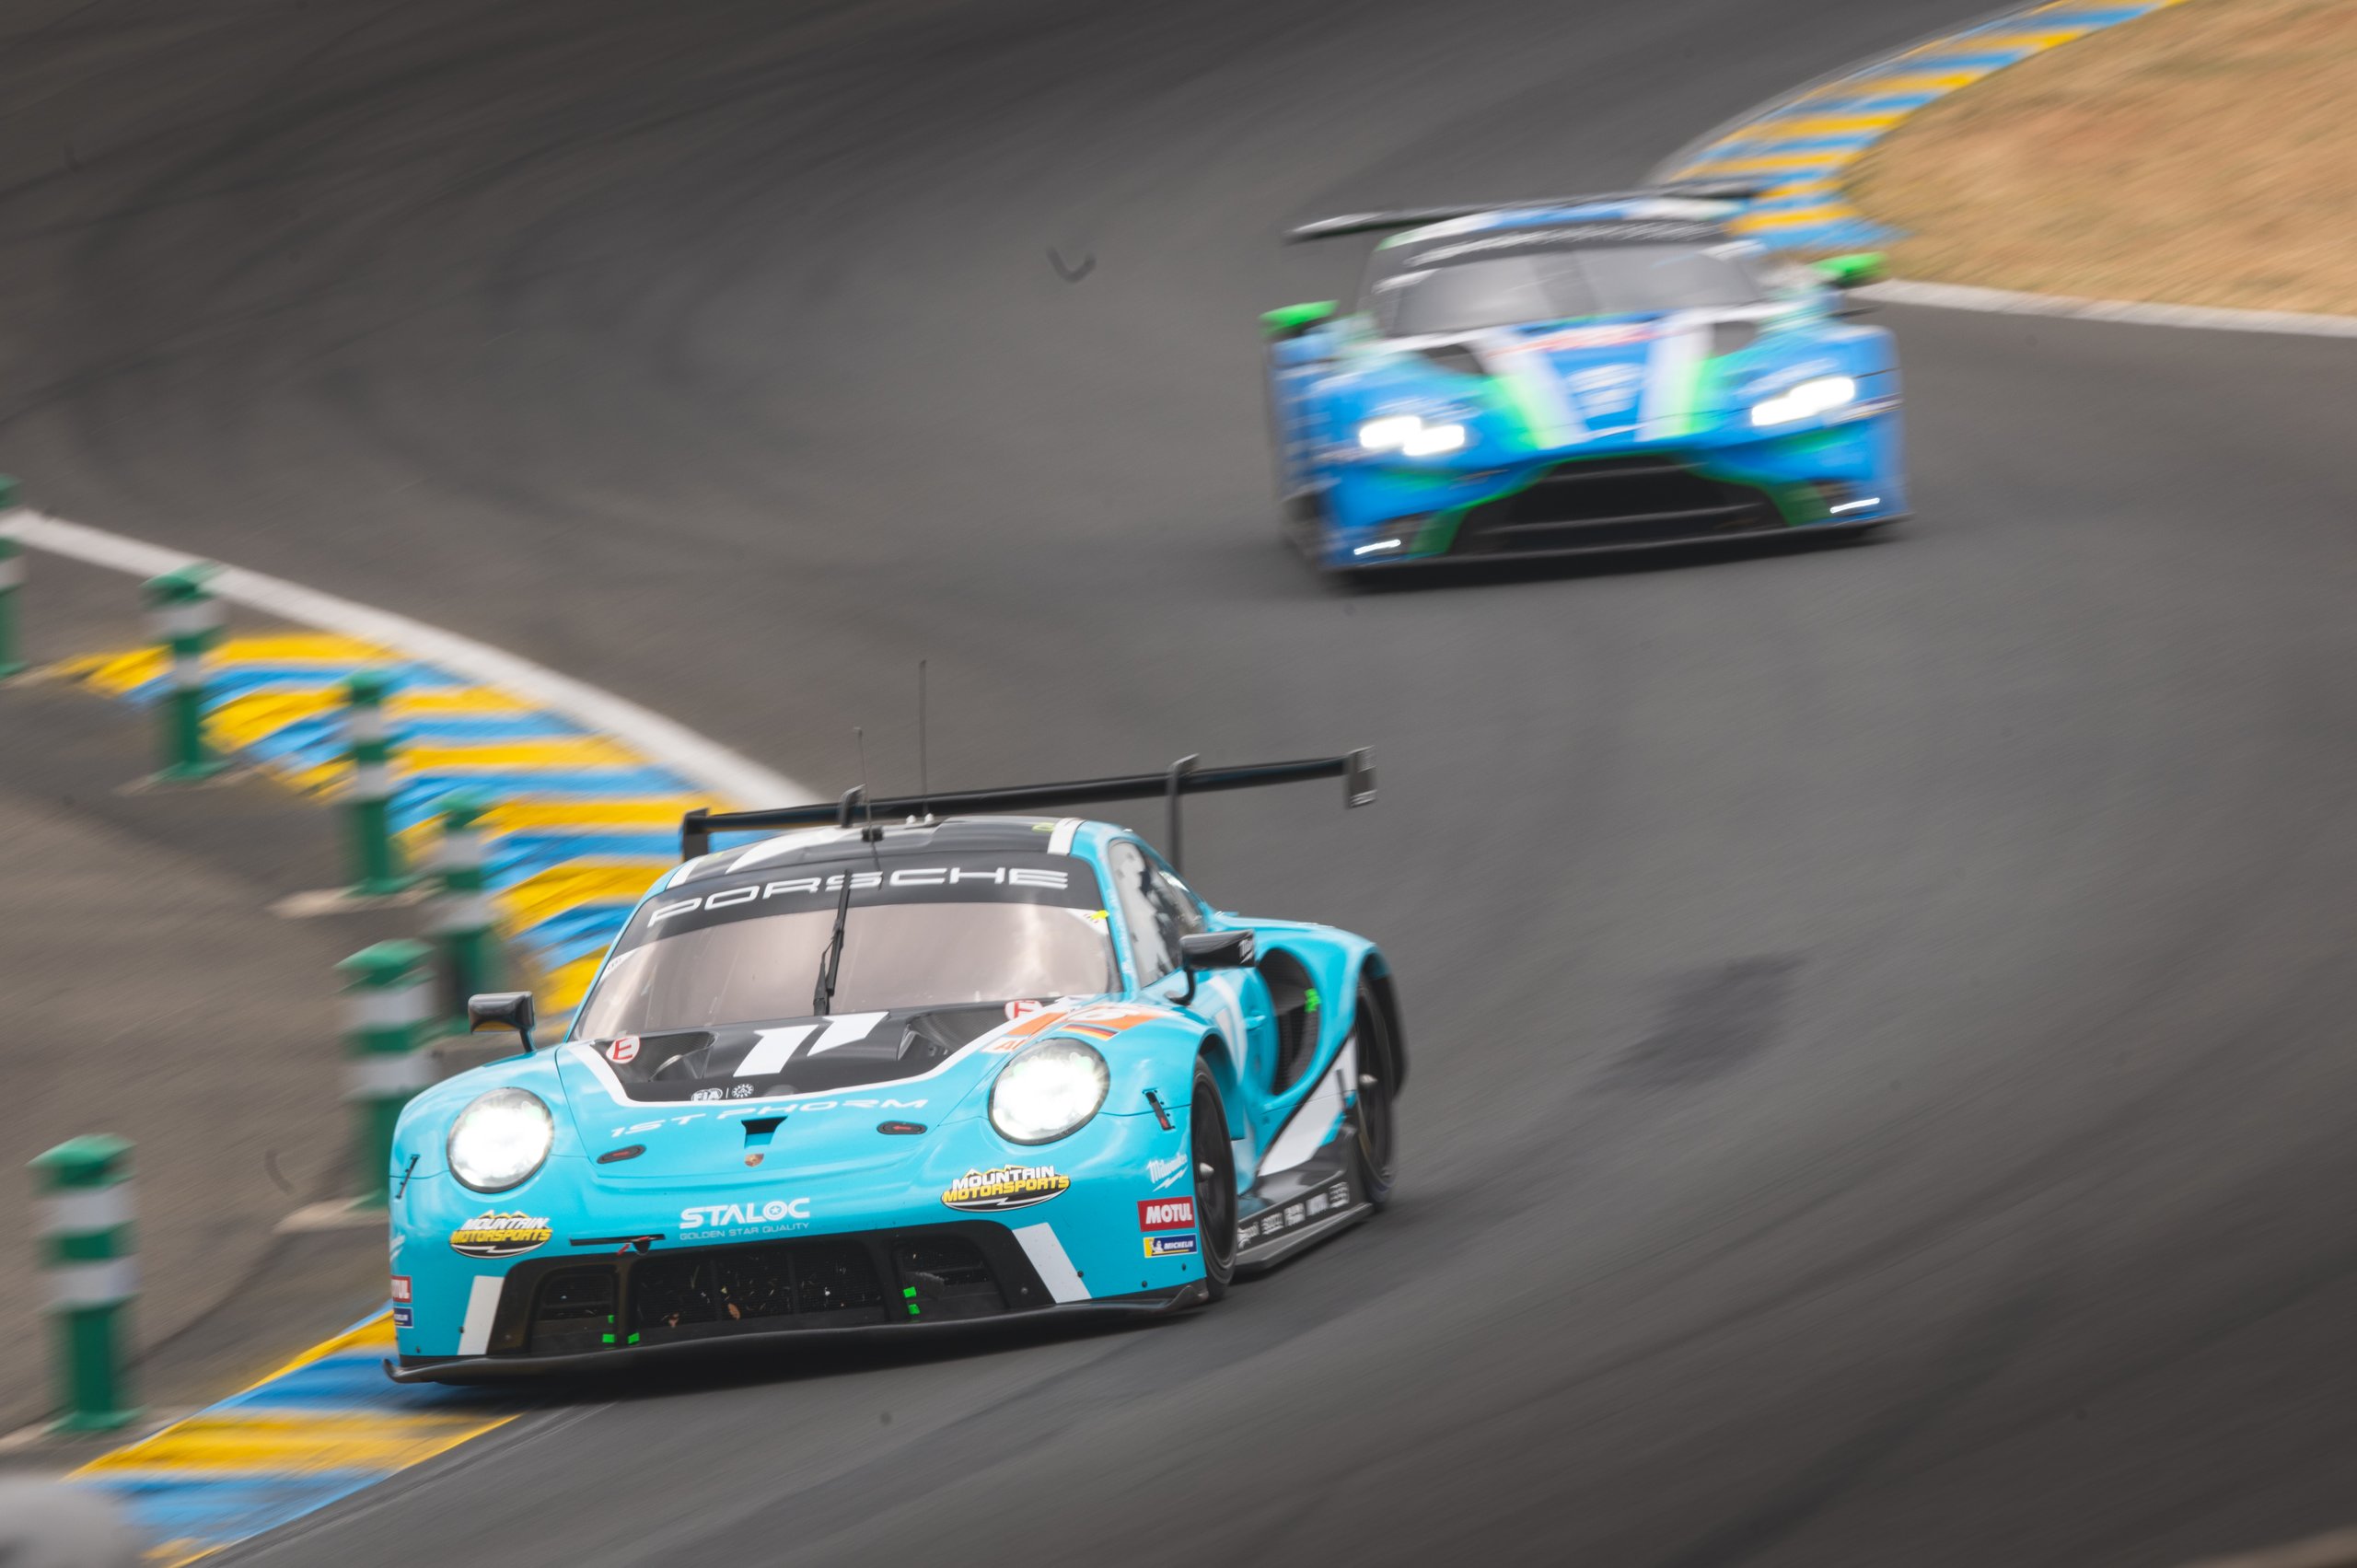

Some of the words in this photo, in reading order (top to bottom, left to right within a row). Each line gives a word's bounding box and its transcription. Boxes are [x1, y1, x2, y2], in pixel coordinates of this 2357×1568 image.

[647, 867, 1068, 927] PORSCHE
[613, 1039, 633, 1060] E
[611, 1114, 706, 1138] 1ST
[716, 1098, 929, 1121] PHORM
[943, 1176, 1070, 1202] MOTORSPORTS
[952, 1166, 1055, 1191] MOUNTAIN
[460, 1217, 550, 1230] MOUNTAIN
[679, 1197, 810, 1229] STALOC
[1145, 1202, 1193, 1225] MOTUL
[450, 1228, 552, 1243] MOTORSPORTS
[679, 1230, 725, 1240] GOLDEN
[729, 1226, 759, 1237] STAR
[762, 1223, 809, 1233] QUALITY
[1164, 1240, 1193, 1250] MICHELIN
